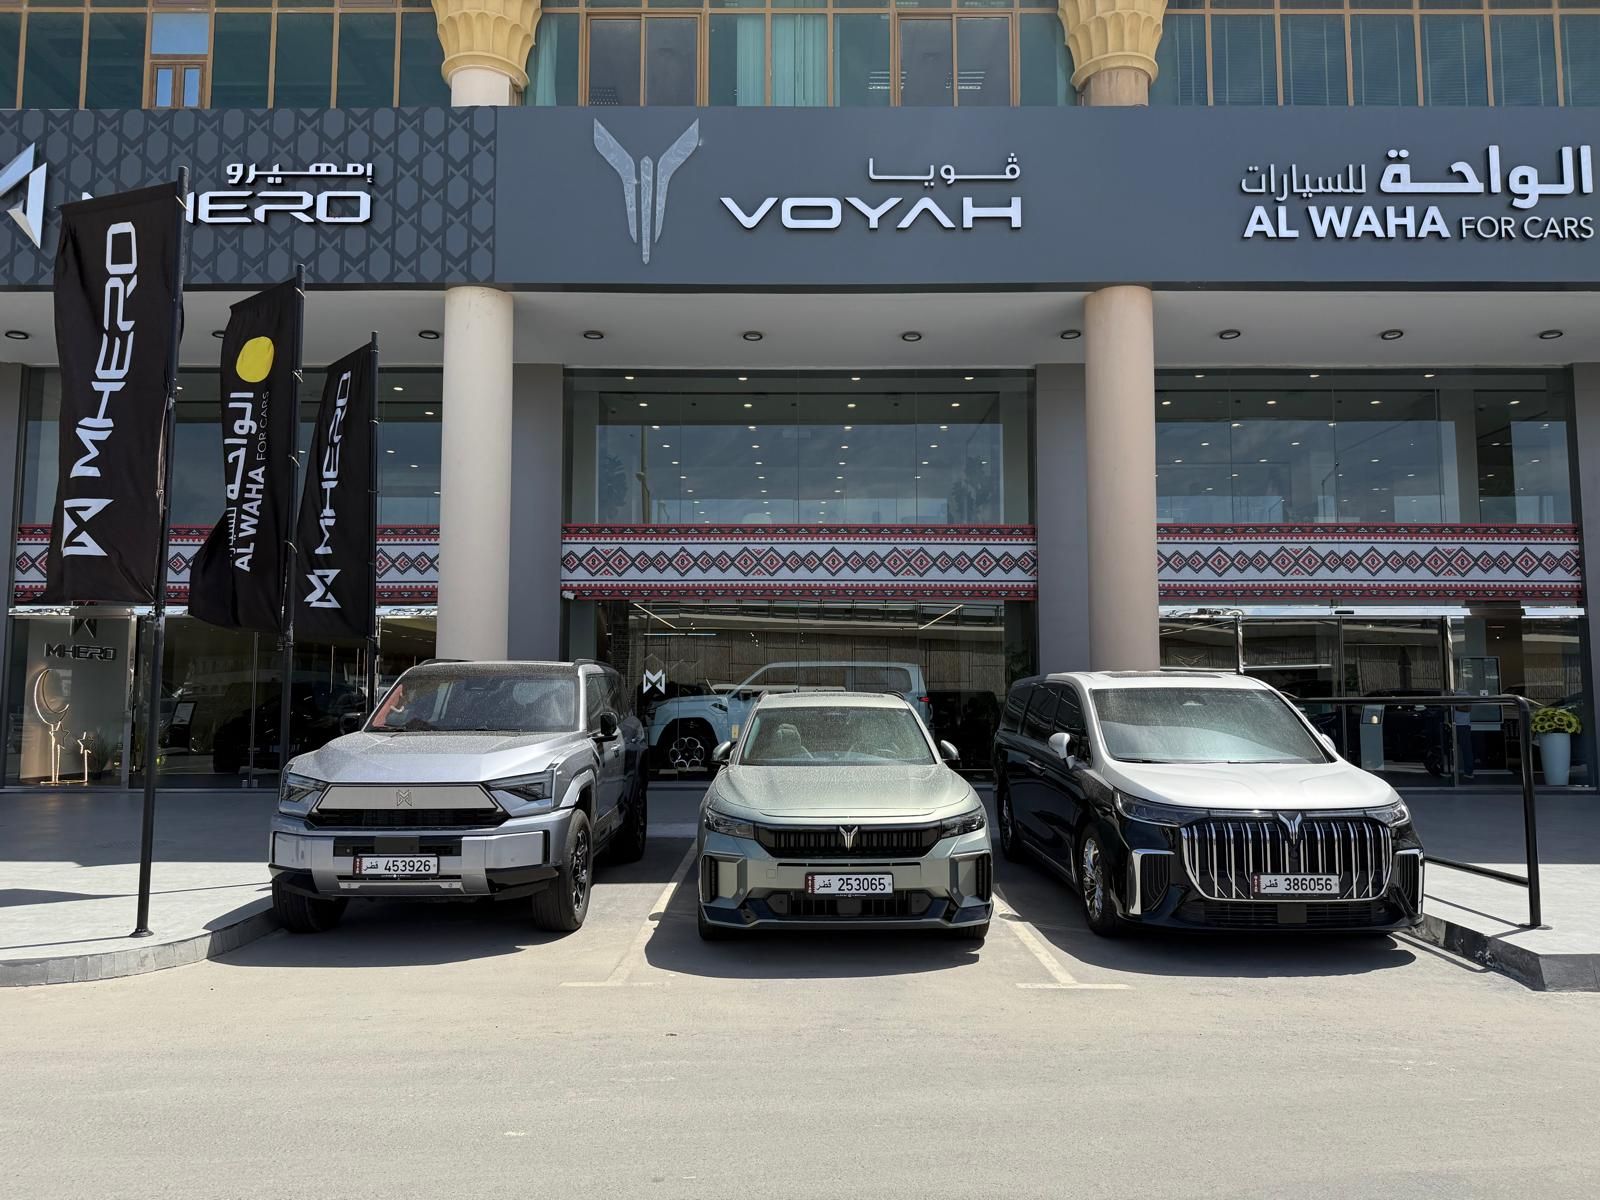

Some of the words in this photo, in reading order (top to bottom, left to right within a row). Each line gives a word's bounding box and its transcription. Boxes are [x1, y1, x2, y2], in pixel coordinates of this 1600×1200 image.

[226, 162, 373, 184] إمهيرو
[1240, 163, 1367, 201] للسيارات
[1379, 144, 1594, 210] الواحة
[82, 190, 371, 224] ERO
[719, 196, 1022, 230] VOYAH
[1243, 205, 1300, 239] AL
[1307, 205, 1452, 239] WAHA
[1460, 215, 1516, 240] FOR
[1523, 215, 1595, 240] CARS
[69, 220, 138, 478] MHERO
[259, 391, 270, 430] CARS
[256, 431, 268, 462] FOR
[314, 370, 351, 555] MHERO
[238, 465, 266, 538] WAHA
[234, 542, 255, 573] AL
[363, 860, 379, 872] قطر
[384, 859, 432, 873] 453926
[816, 878, 833, 891] قطر
[837, 877, 887, 892] 253065
[1263, 878, 1279, 890] قطر
[1284, 877, 1333, 892] 386056
